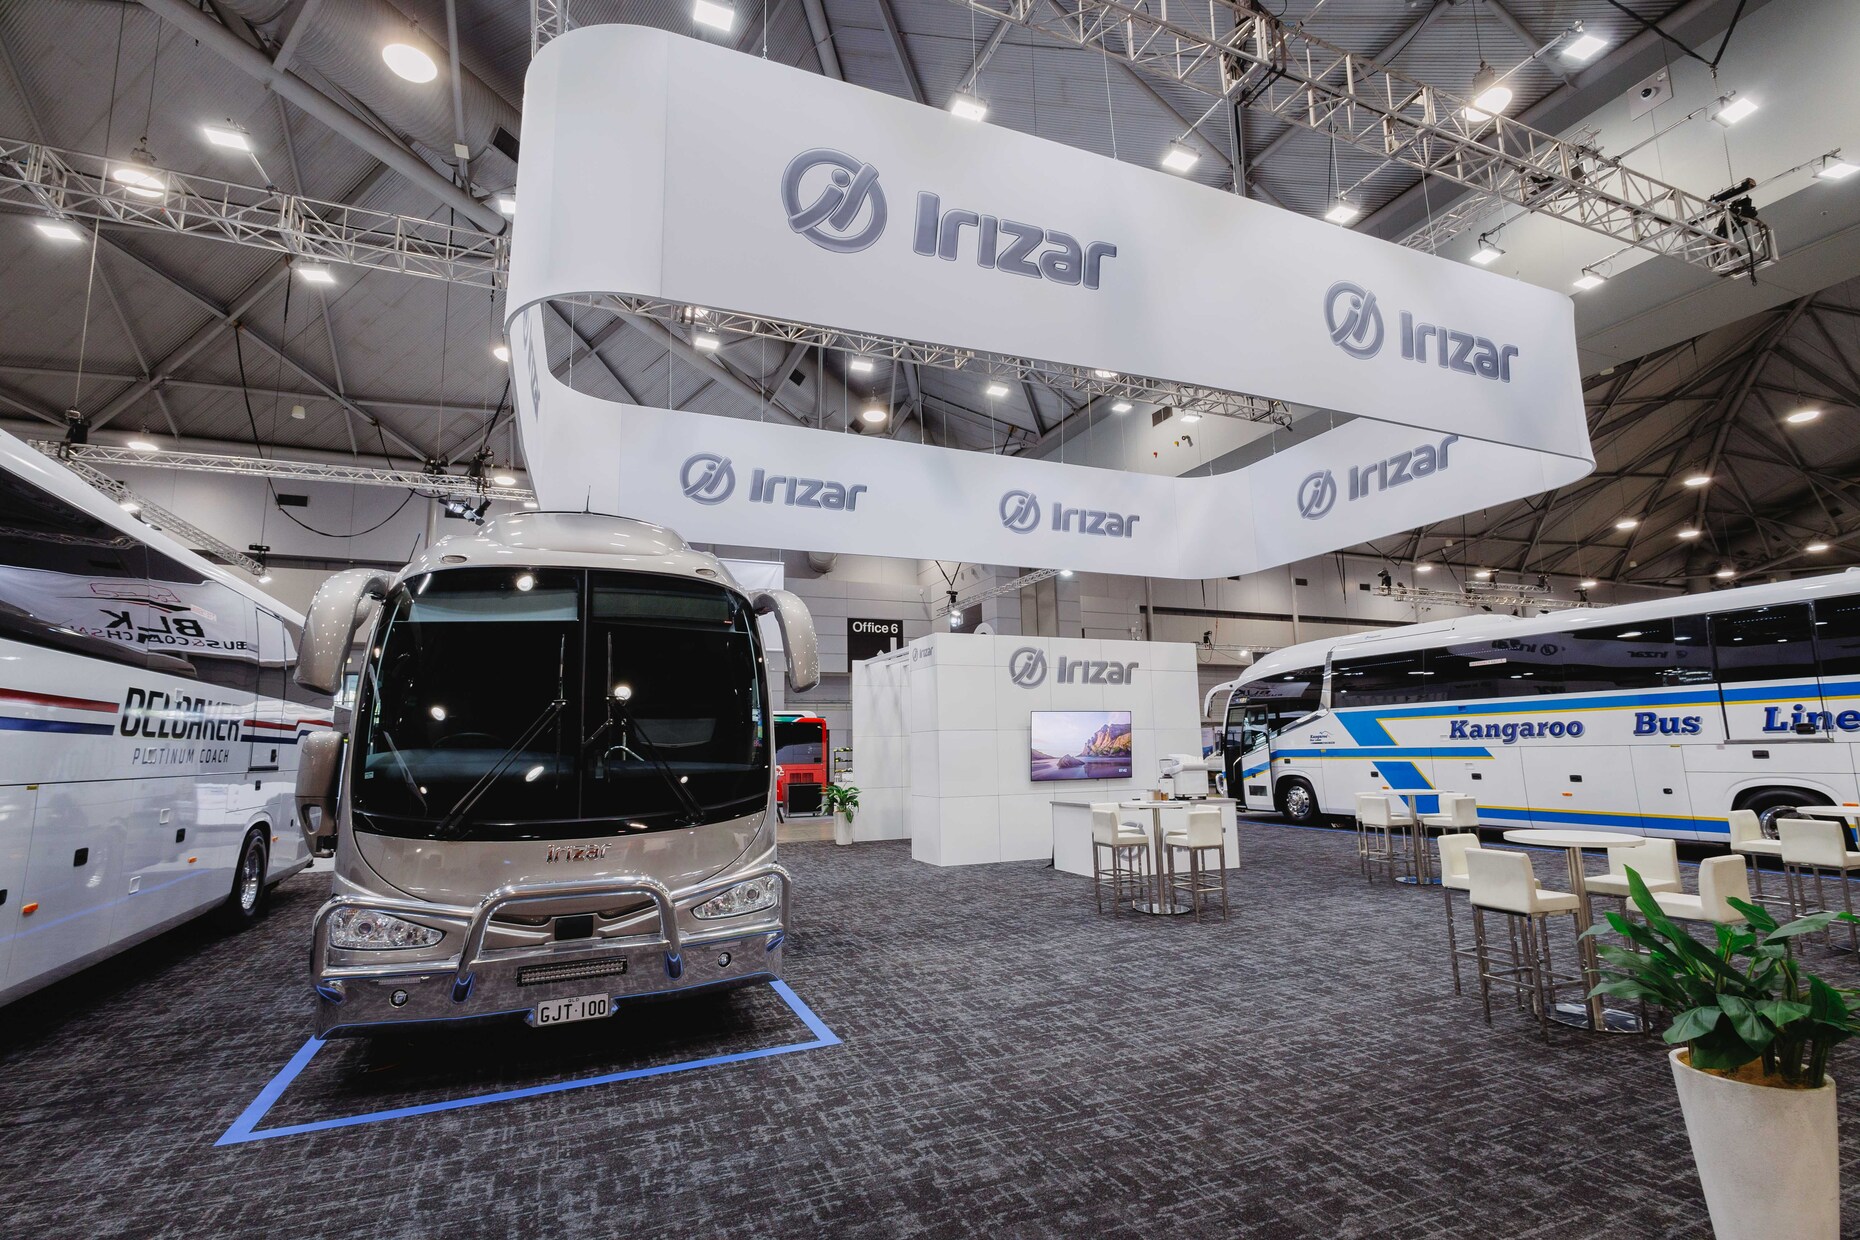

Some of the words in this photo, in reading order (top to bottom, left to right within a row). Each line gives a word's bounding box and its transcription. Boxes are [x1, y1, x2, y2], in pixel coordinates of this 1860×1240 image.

[913, 191, 1117, 290] Irizar
[1399, 310, 1519, 383] Irizar
[1348, 435, 1459, 501] Irizar
[749, 467, 868, 512] Irizar
[1051, 502, 1140, 538] Irizar
[852, 621, 889, 633] Office
[890, 623, 898, 634] 6
[1057, 656, 1140, 685] Irizar
[1449, 720, 1584, 745] Kangaroo
[1633, 711, 1704, 737] Bus
[199, 749, 230, 764] COACH
[546, 843, 612, 864] Irizar
